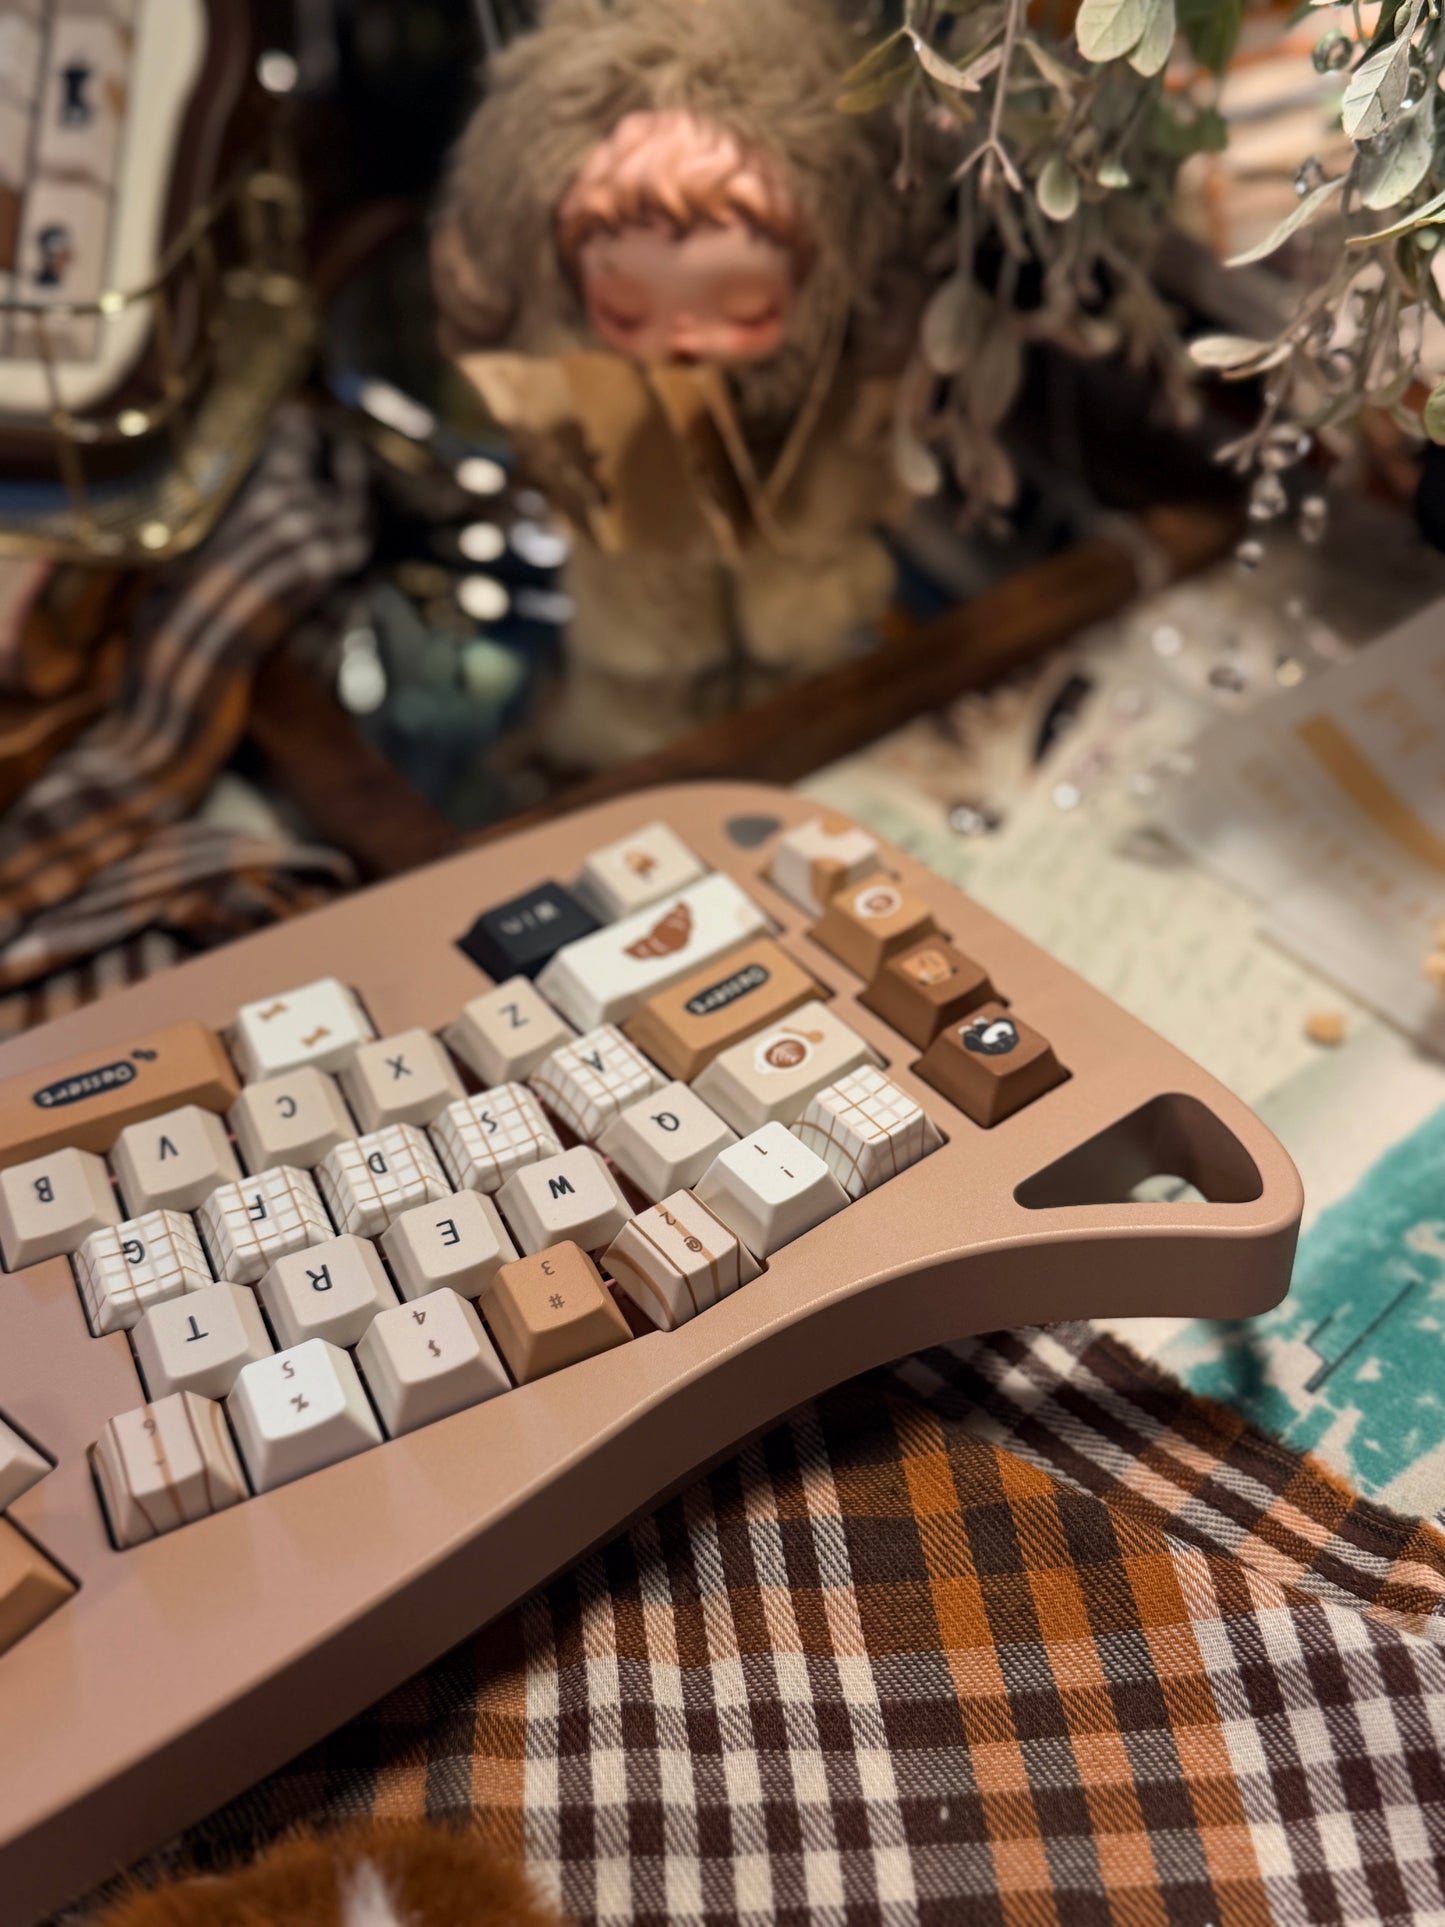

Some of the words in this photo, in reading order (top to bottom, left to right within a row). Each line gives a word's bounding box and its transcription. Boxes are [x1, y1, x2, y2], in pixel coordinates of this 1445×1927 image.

[497, 1003, 529, 1029] Z
[384, 1054, 412, 1080] X
[581, 1051, 605, 1072] A
[276, 1096, 297, 1118] C
[480, 1111, 497, 1134] S
[650, 1112, 680, 1132] Q
[159, 1135, 179, 1161] V
[367, 1152, 388, 1174] D
[34, 1176, 54, 1202] B
[548, 1175, 576, 1199] W
[248, 1194, 267, 1222] F
[659, 1211, 676, 1227] 2
[436, 1219, 460, 1246] E
[684, 1235, 703, 1253] @
[121, 1239, 145, 1264] G
[305, 1264, 332, 1292] R
[540, 1260, 556, 1276] 3
[548, 1293, 566, 1309] #
[186, 1315, 209, 1342] T
[411, 1310, 426, 1326] 4
[282, 1360, 296, 1380] 5
